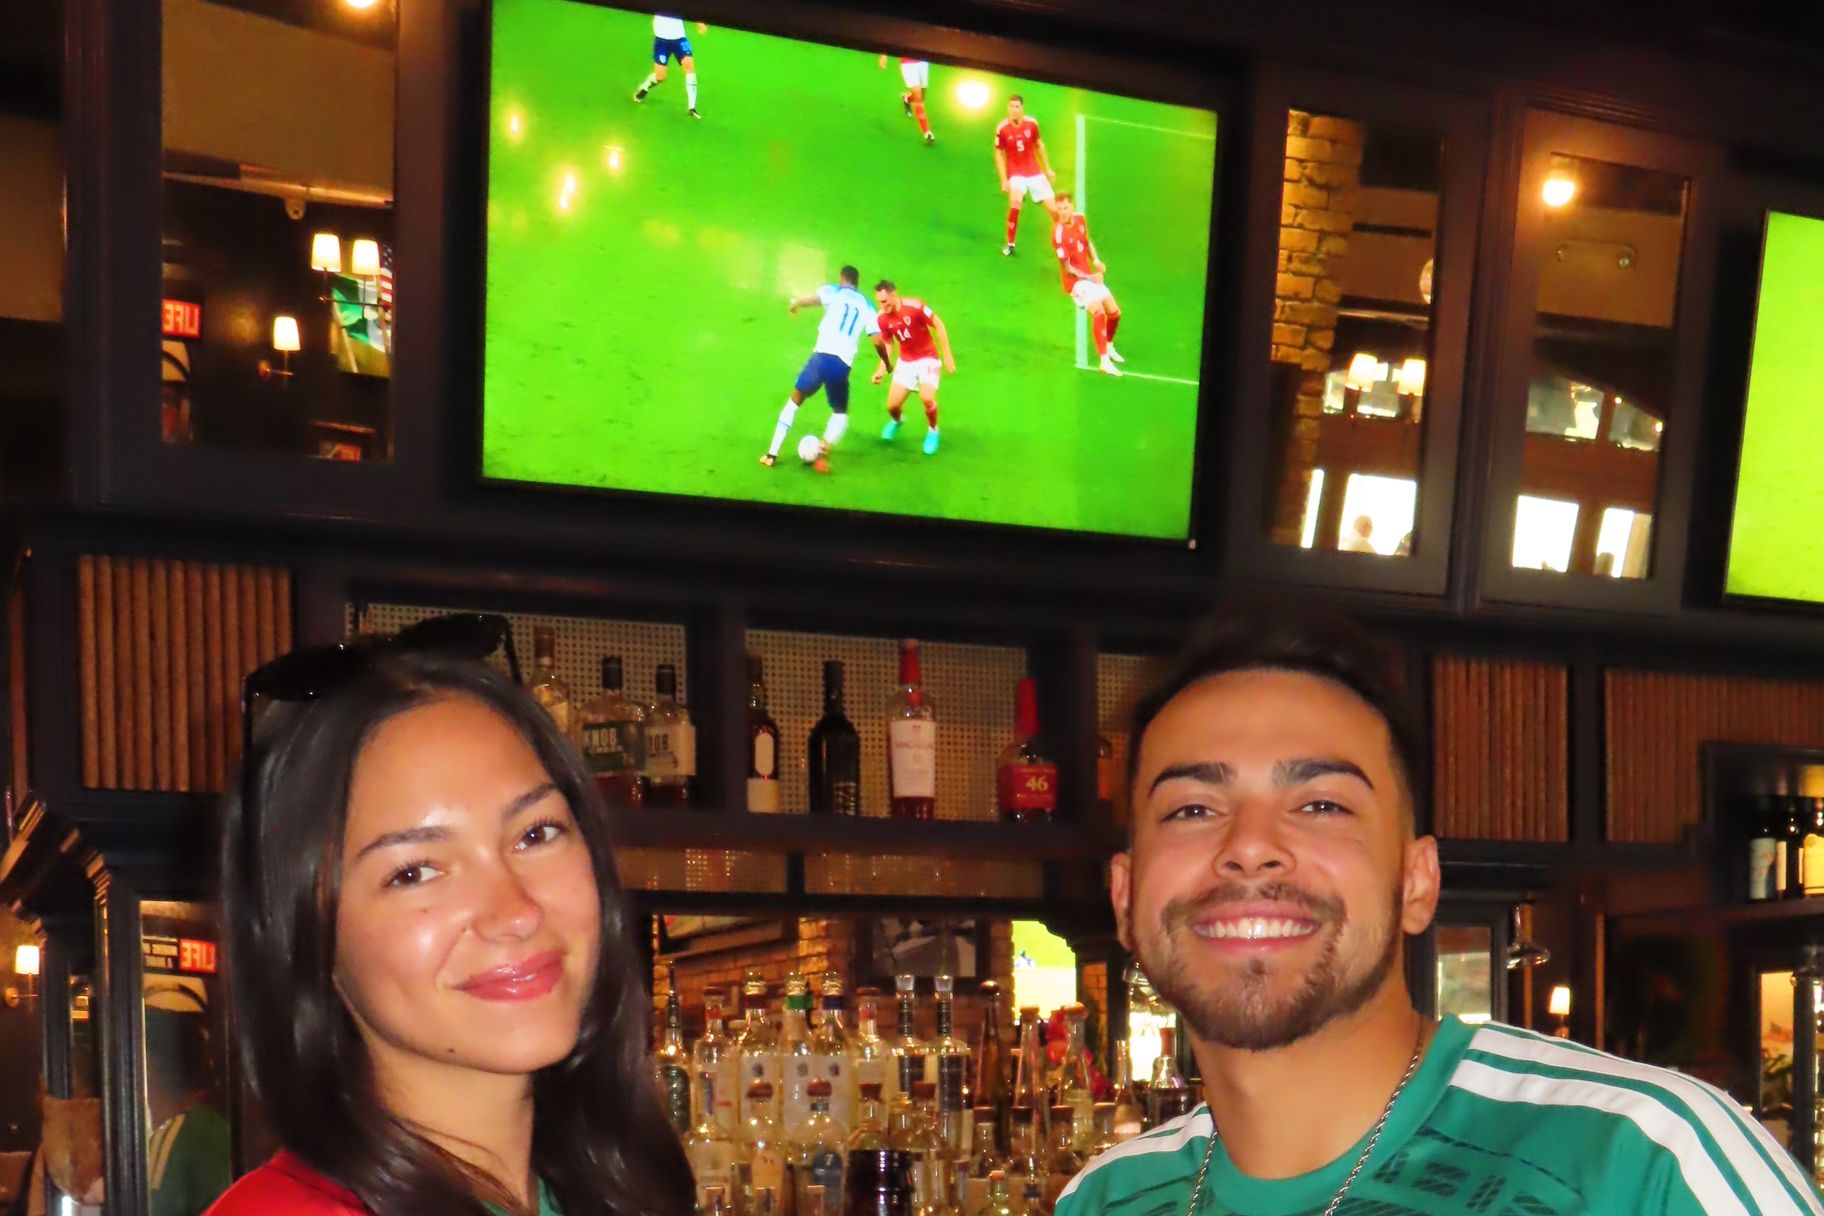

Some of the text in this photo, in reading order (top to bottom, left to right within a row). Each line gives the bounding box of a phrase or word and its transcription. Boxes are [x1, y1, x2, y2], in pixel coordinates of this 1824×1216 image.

[840, 303, 859, 336] 11
[582, 728, 617, 748] KNOB
[1025, 776, 1048, 792] 46
